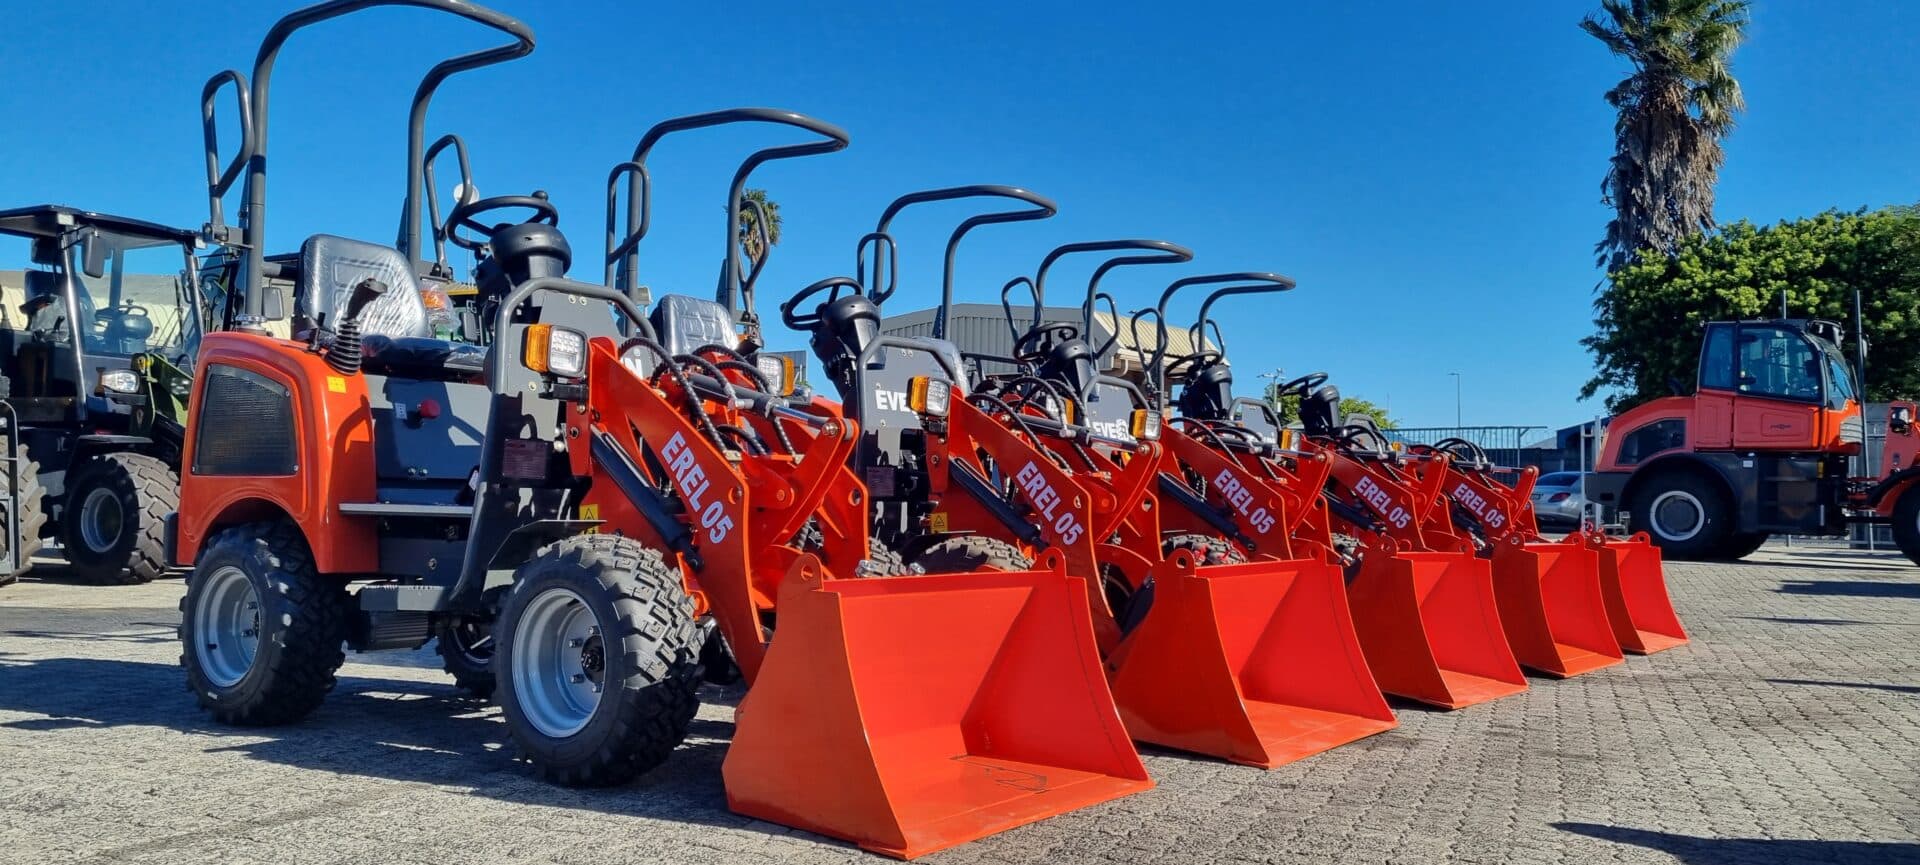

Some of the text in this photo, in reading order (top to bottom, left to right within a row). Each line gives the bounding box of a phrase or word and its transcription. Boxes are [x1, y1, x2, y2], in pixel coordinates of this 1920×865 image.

[875, 389, 913, 413] EVE
[661, 431, 734, 544] EREL 05
[1016, 460, 1084, 545] EREL 05
[1214, 468, 1276, 534] EREL 05
[1355, 475, 1412, 529] EREL 05
[1453, 482, 1506, 528] EREL 05
